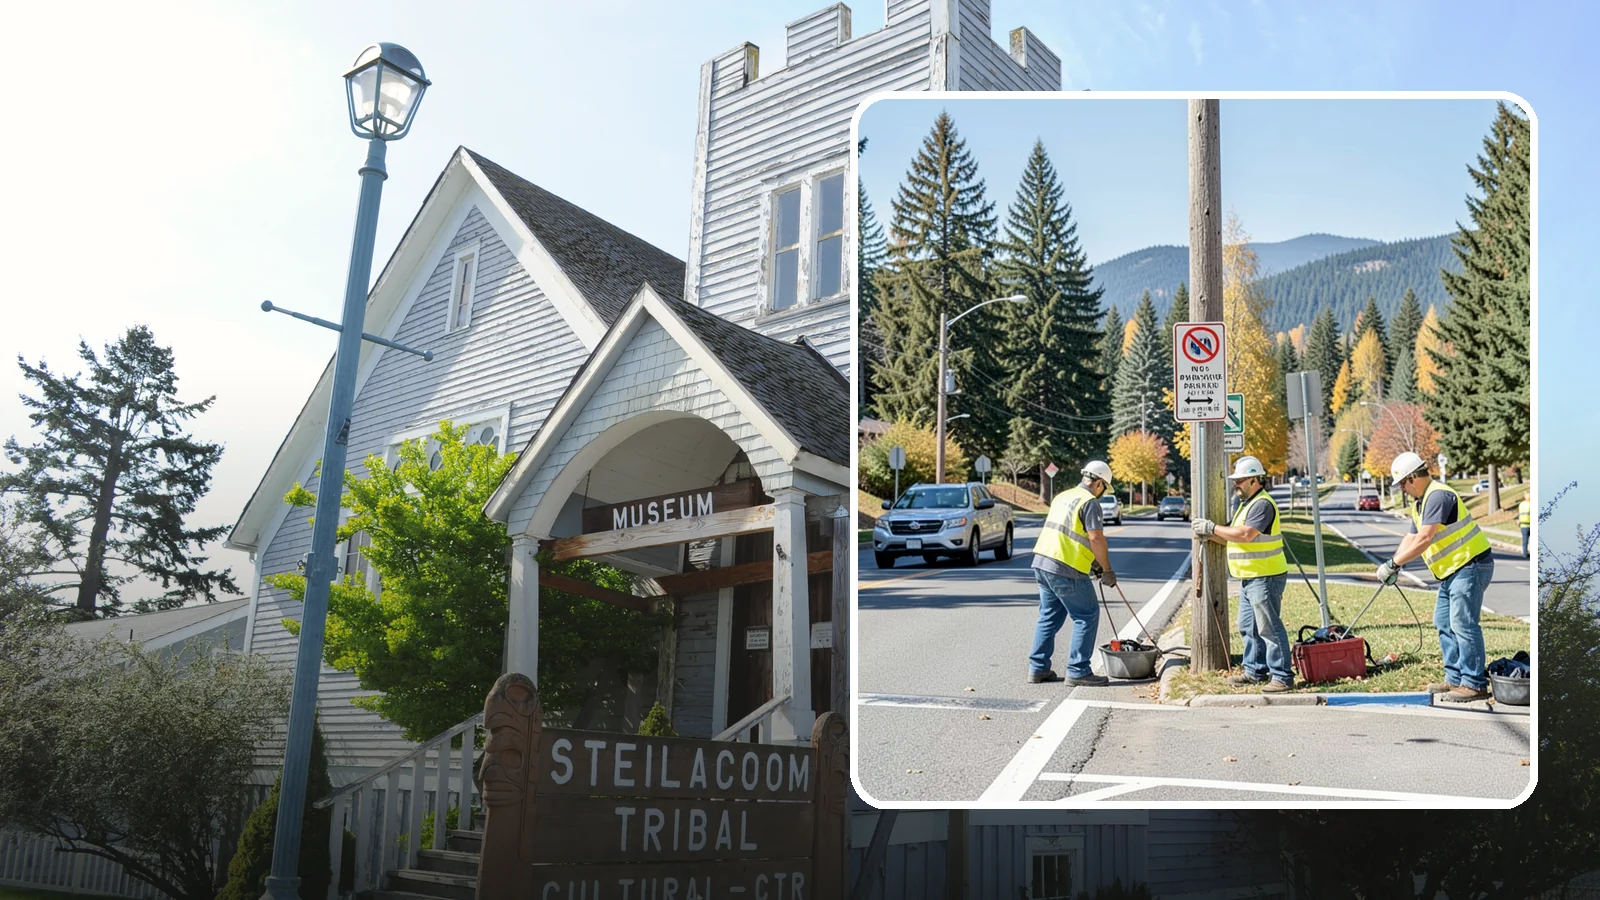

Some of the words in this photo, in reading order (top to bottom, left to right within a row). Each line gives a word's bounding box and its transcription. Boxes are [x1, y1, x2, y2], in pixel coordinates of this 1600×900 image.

[613, 492, 713, 530] MUSEUM
[550, 738, 809, 792] STEILACOOM
[615, 806, 758, 852] TRIBAL
